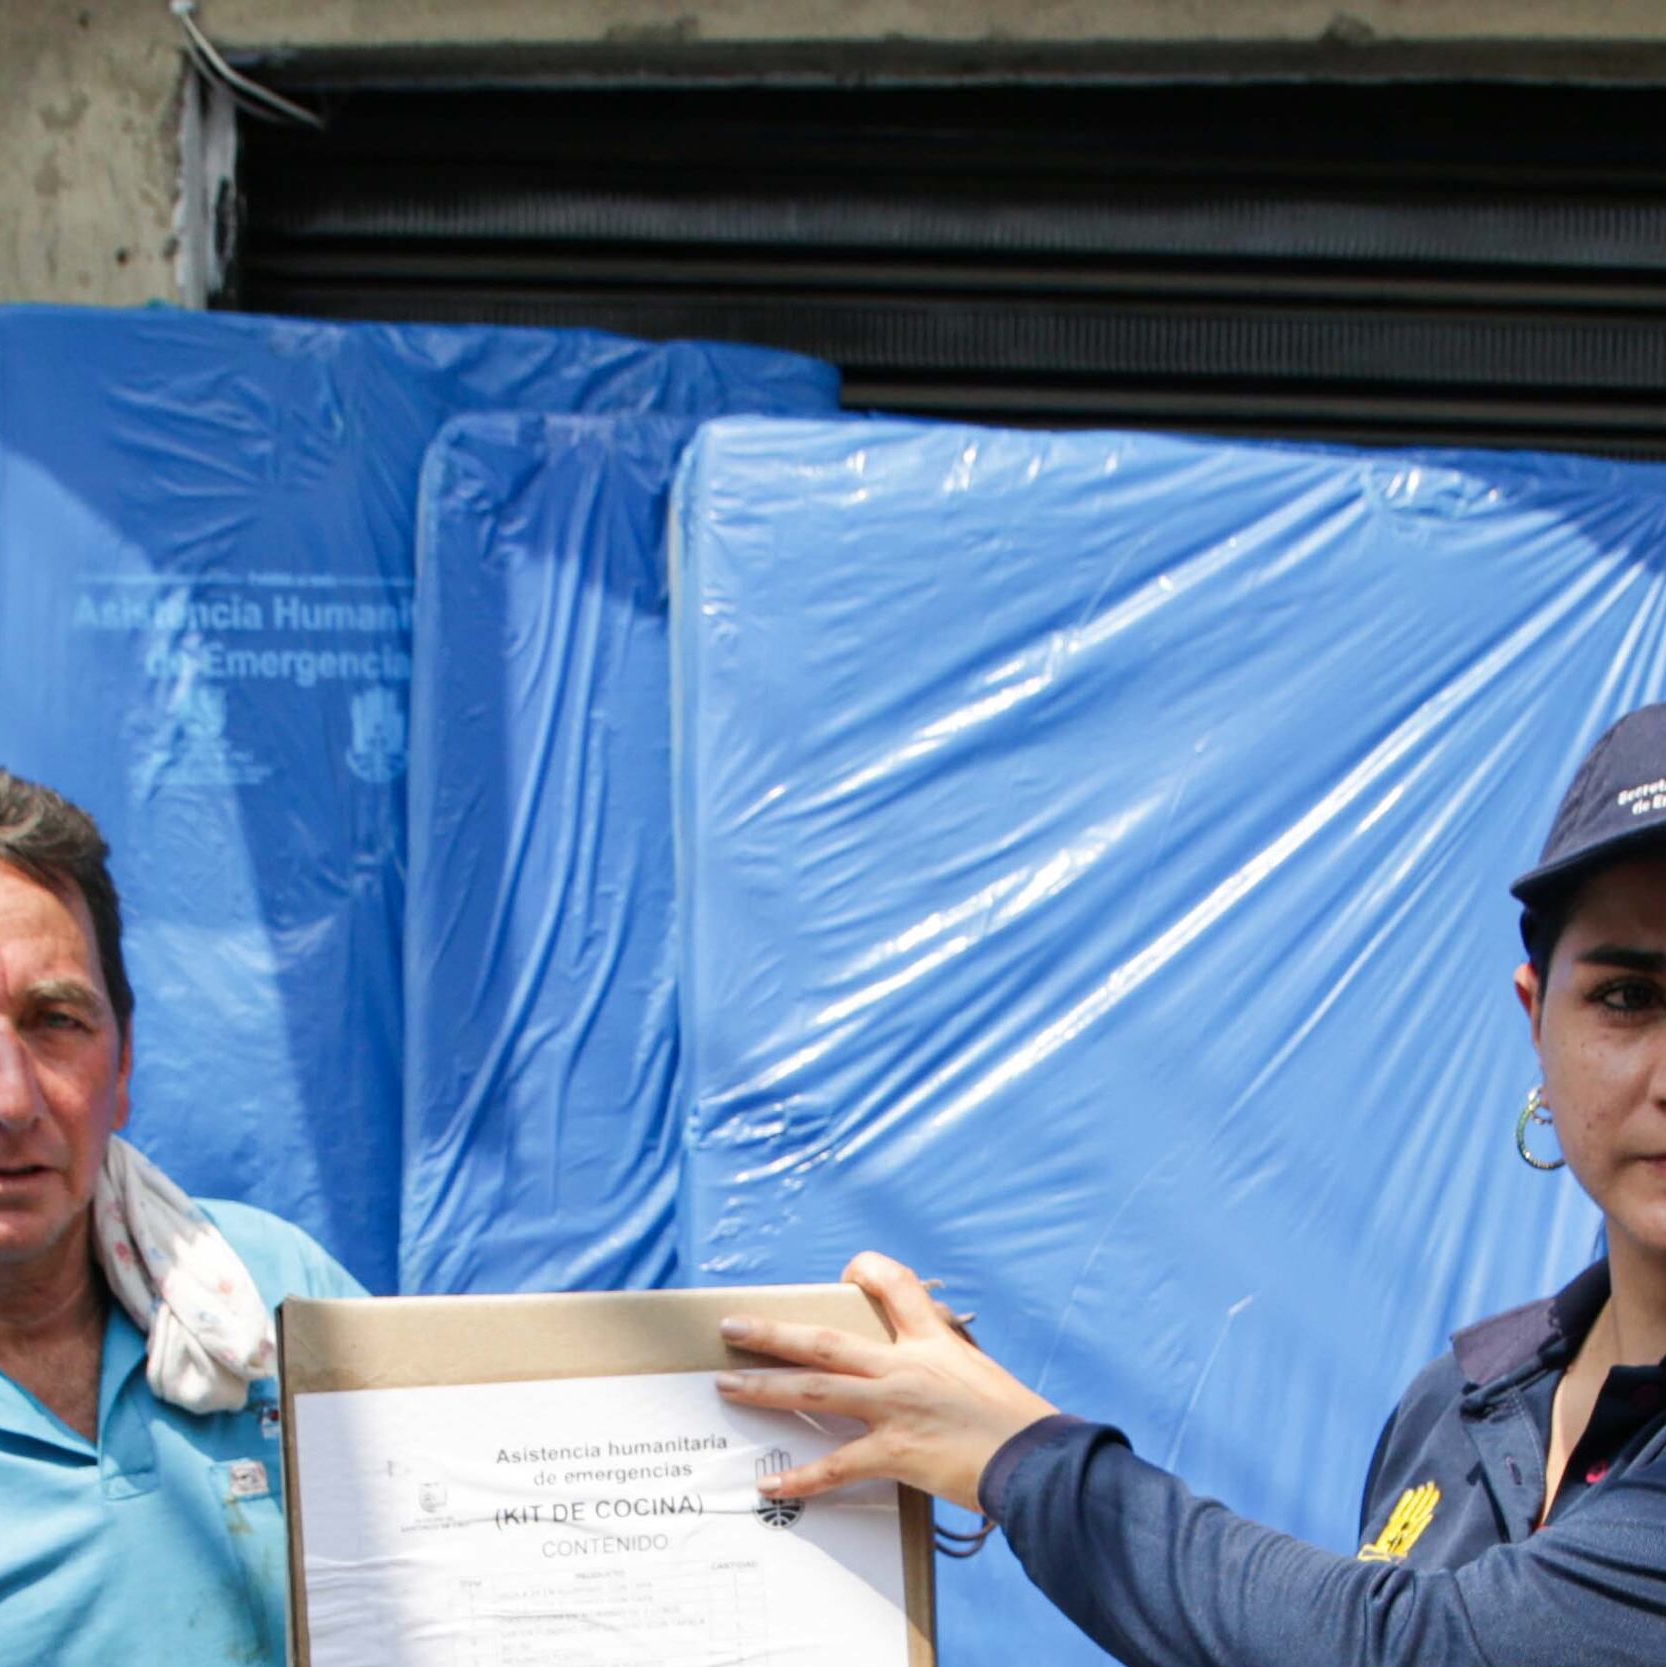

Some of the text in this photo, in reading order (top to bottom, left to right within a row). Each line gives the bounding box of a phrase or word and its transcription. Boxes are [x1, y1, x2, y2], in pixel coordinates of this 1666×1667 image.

[1632, 797, 1651, 816] de
[496, 1433, 728, 1465] Asistencia humanitaria
[533, 1461, 694, 1486] de emergencias
[495, 1503, 544, 1530] (KIT
[553, 1501, 586, 1523] DE
[595, 1494, 705, 1519] COCINA)
[541, 1533, 669, 1559] CONTENIDO
